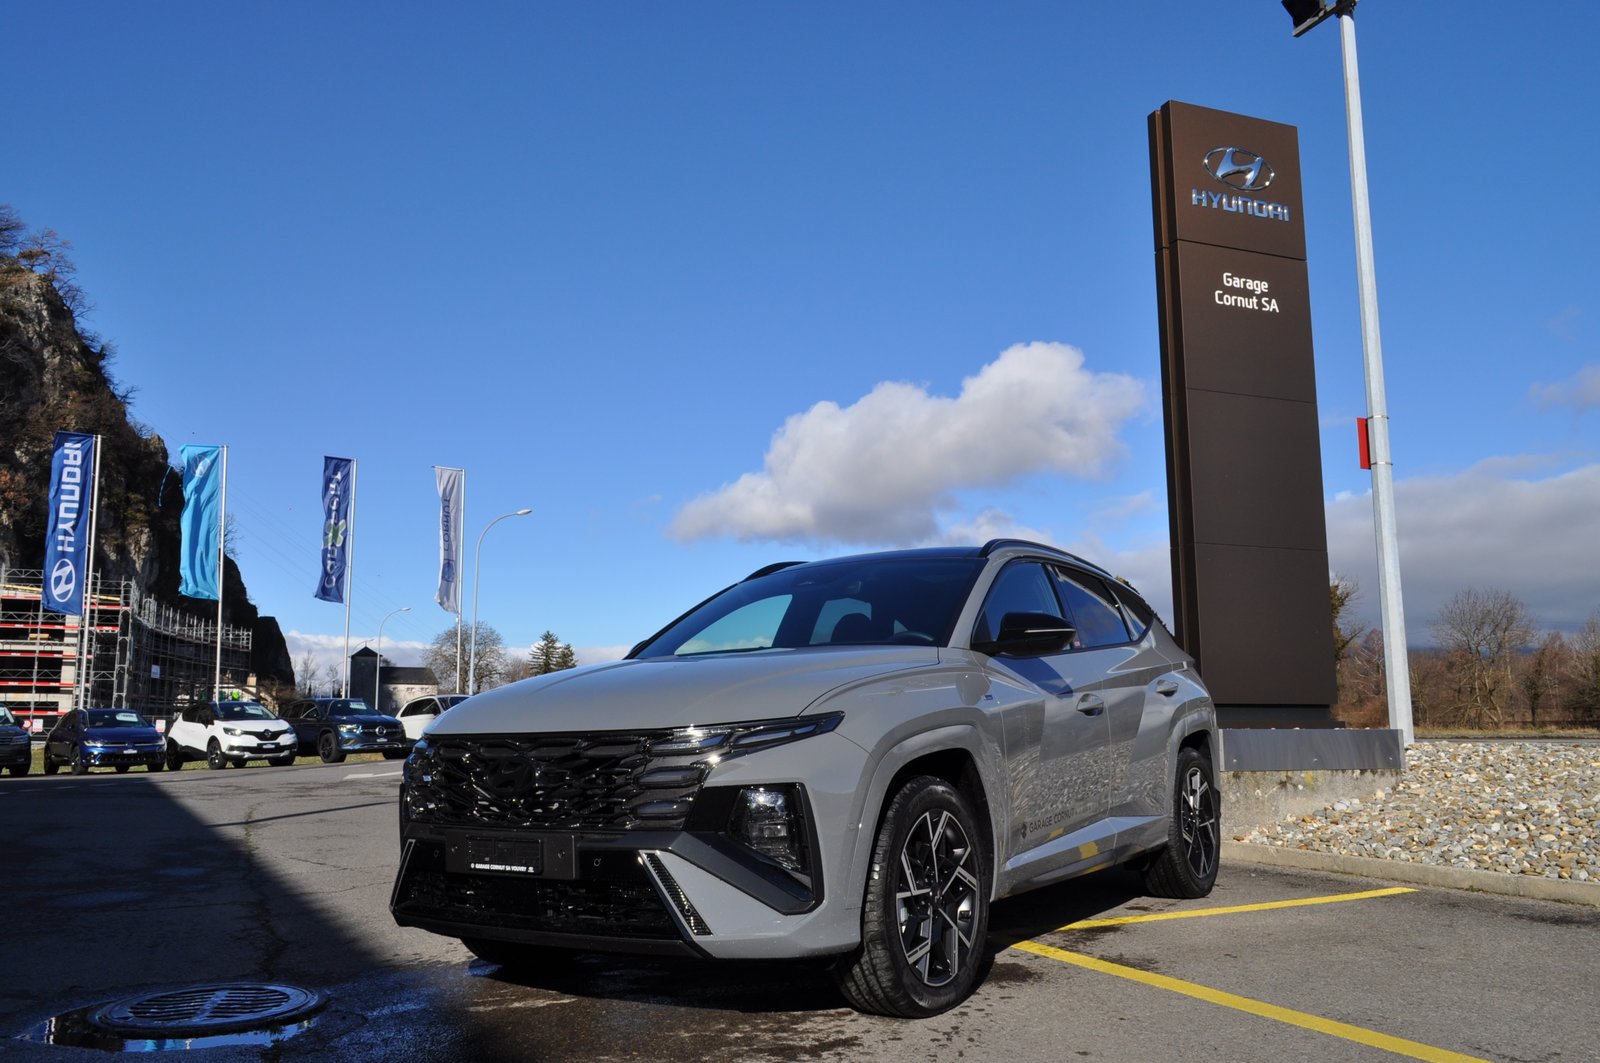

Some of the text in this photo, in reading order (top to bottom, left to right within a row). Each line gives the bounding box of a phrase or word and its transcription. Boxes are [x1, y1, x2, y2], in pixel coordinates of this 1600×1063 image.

[1192, 189, 1290, 222] HYUNDAI
[1223, 272, 1269, 294] Garage
[1215, 290, 1279, 313] Cornut SA
[1029, 815, 1053, 833] GARAGE
